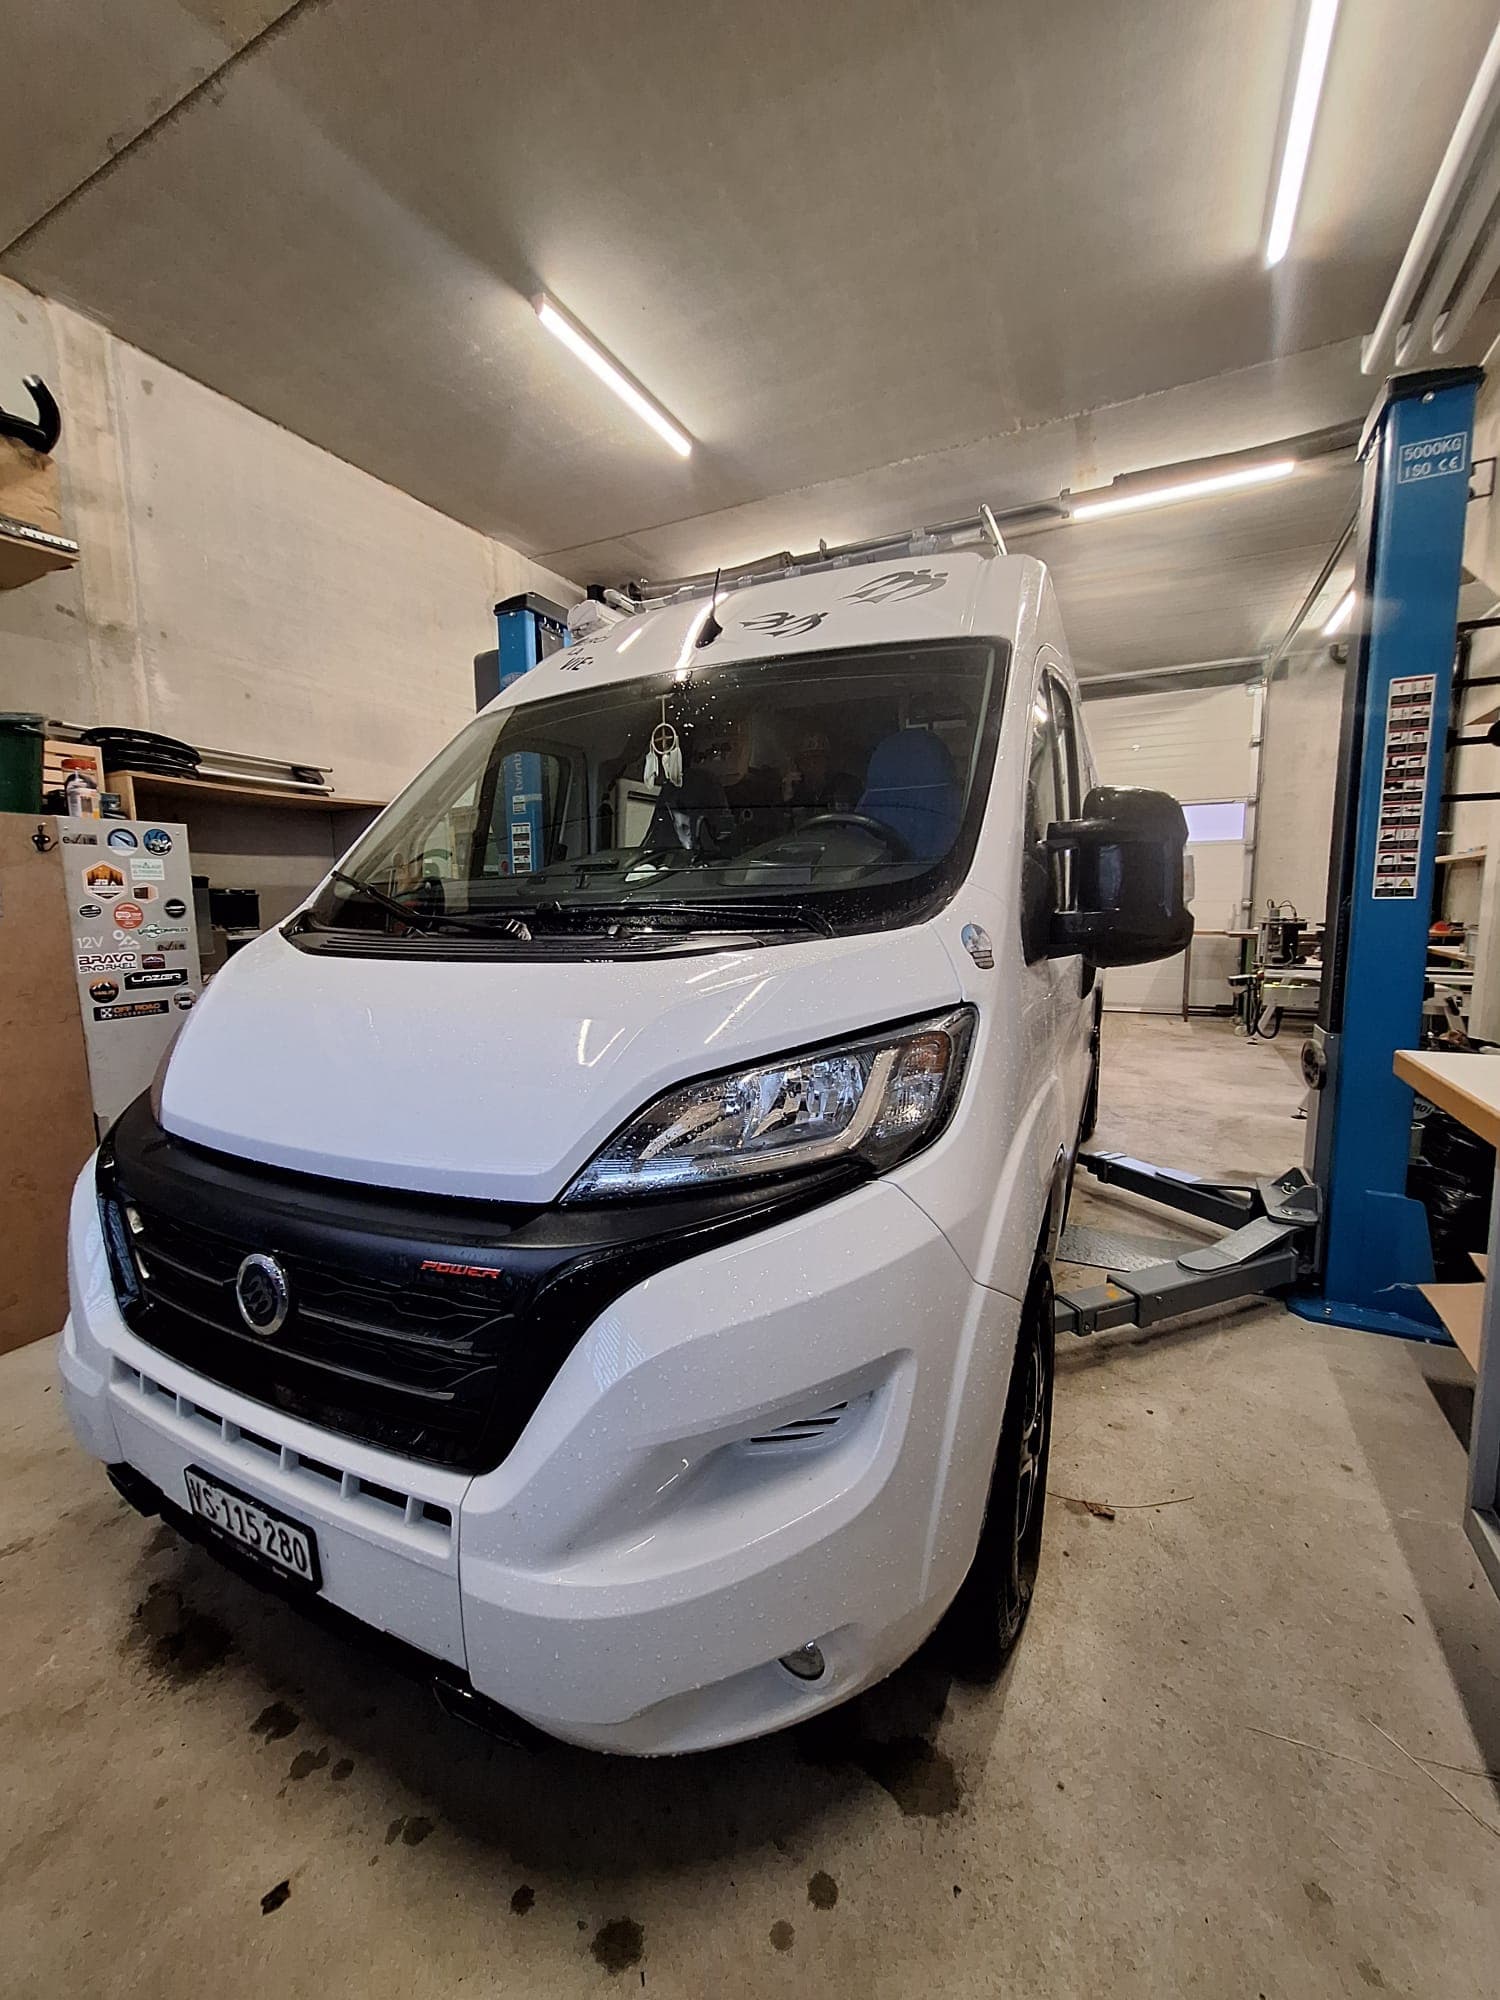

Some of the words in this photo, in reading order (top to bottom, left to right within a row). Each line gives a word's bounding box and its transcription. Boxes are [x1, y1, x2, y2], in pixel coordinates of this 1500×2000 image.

[1404, 437, 1462, 461] 5000KG
[1404, 463, 1431, 479] ISO
[1438, 456, 1459, 471] CE
[77, 936, 104, 949] 12V
[78, 953, 136, 965] BRAVO
[79, 963, 137, 973] SNORKEL
[131, 973, 181, 983] LAZER
[420, 1260, 502, 1279] POWER
